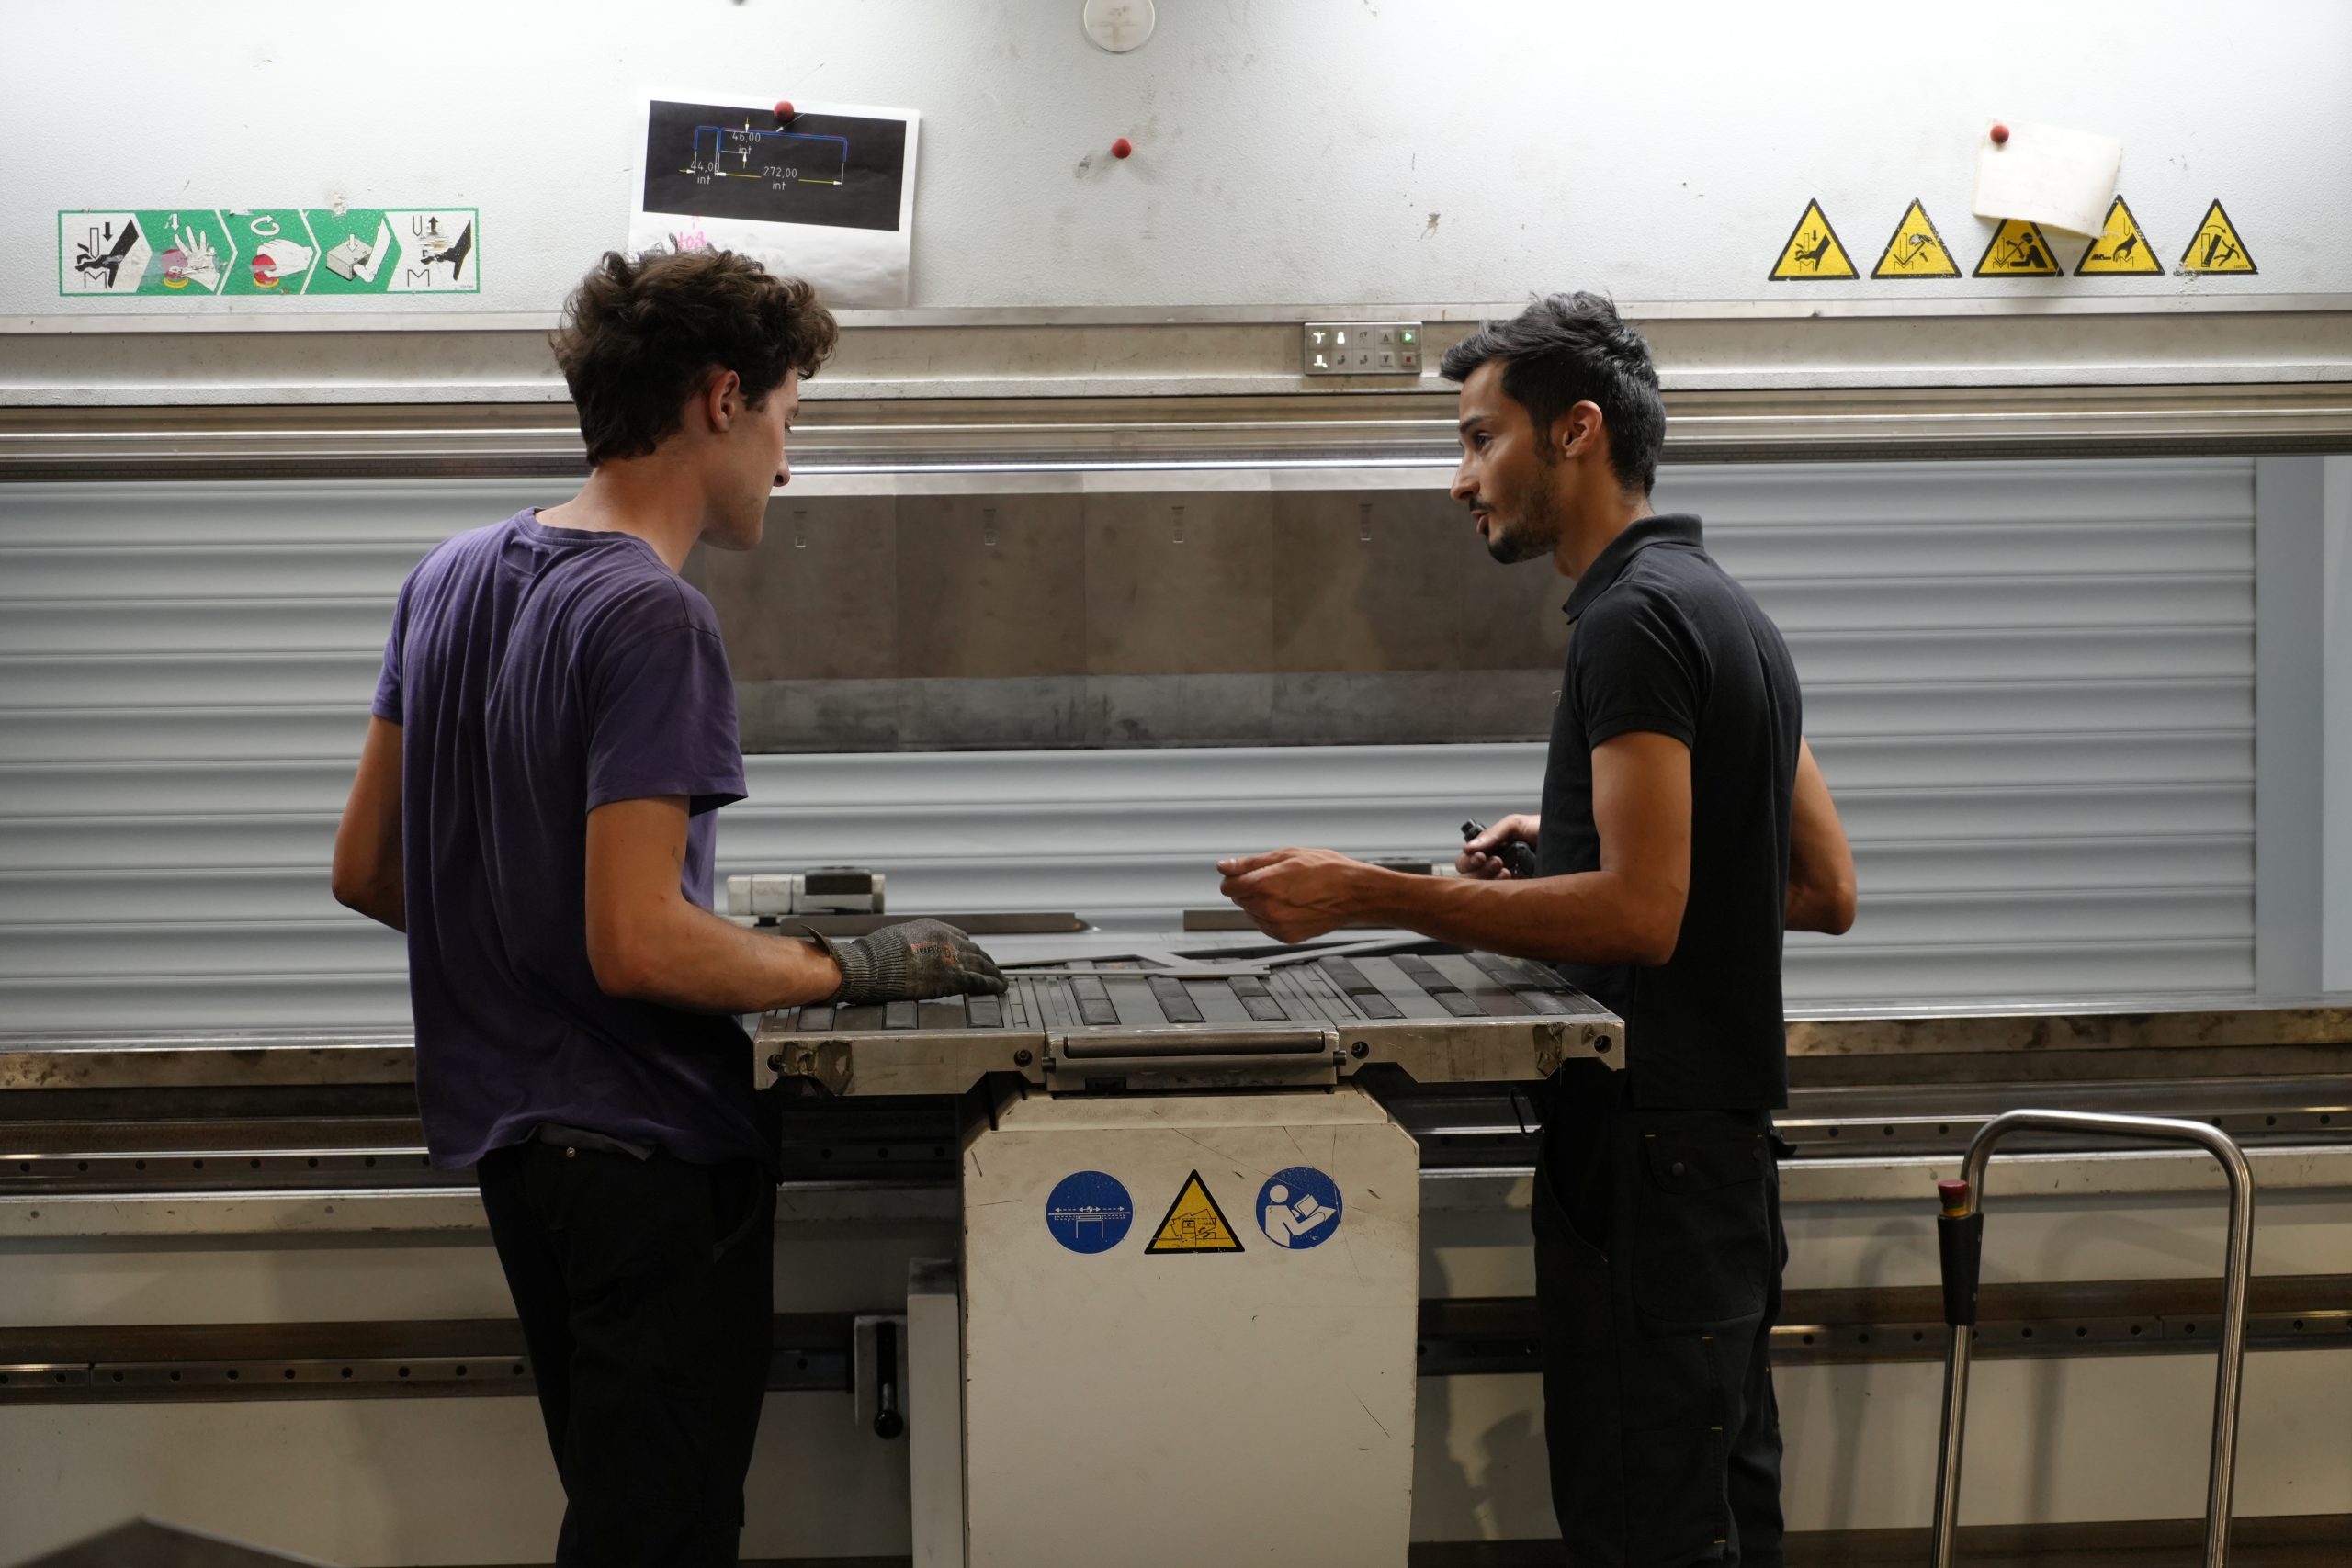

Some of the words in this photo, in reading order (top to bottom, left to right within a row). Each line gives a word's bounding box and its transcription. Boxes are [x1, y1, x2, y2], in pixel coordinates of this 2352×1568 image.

[732, 132, 761, 143] 46,00
[738, 145, 752, 154] int
[763, 166, 797, 178] 272,00
[697, 175, 711, 185] int
[772, 182, 786, 191] int
